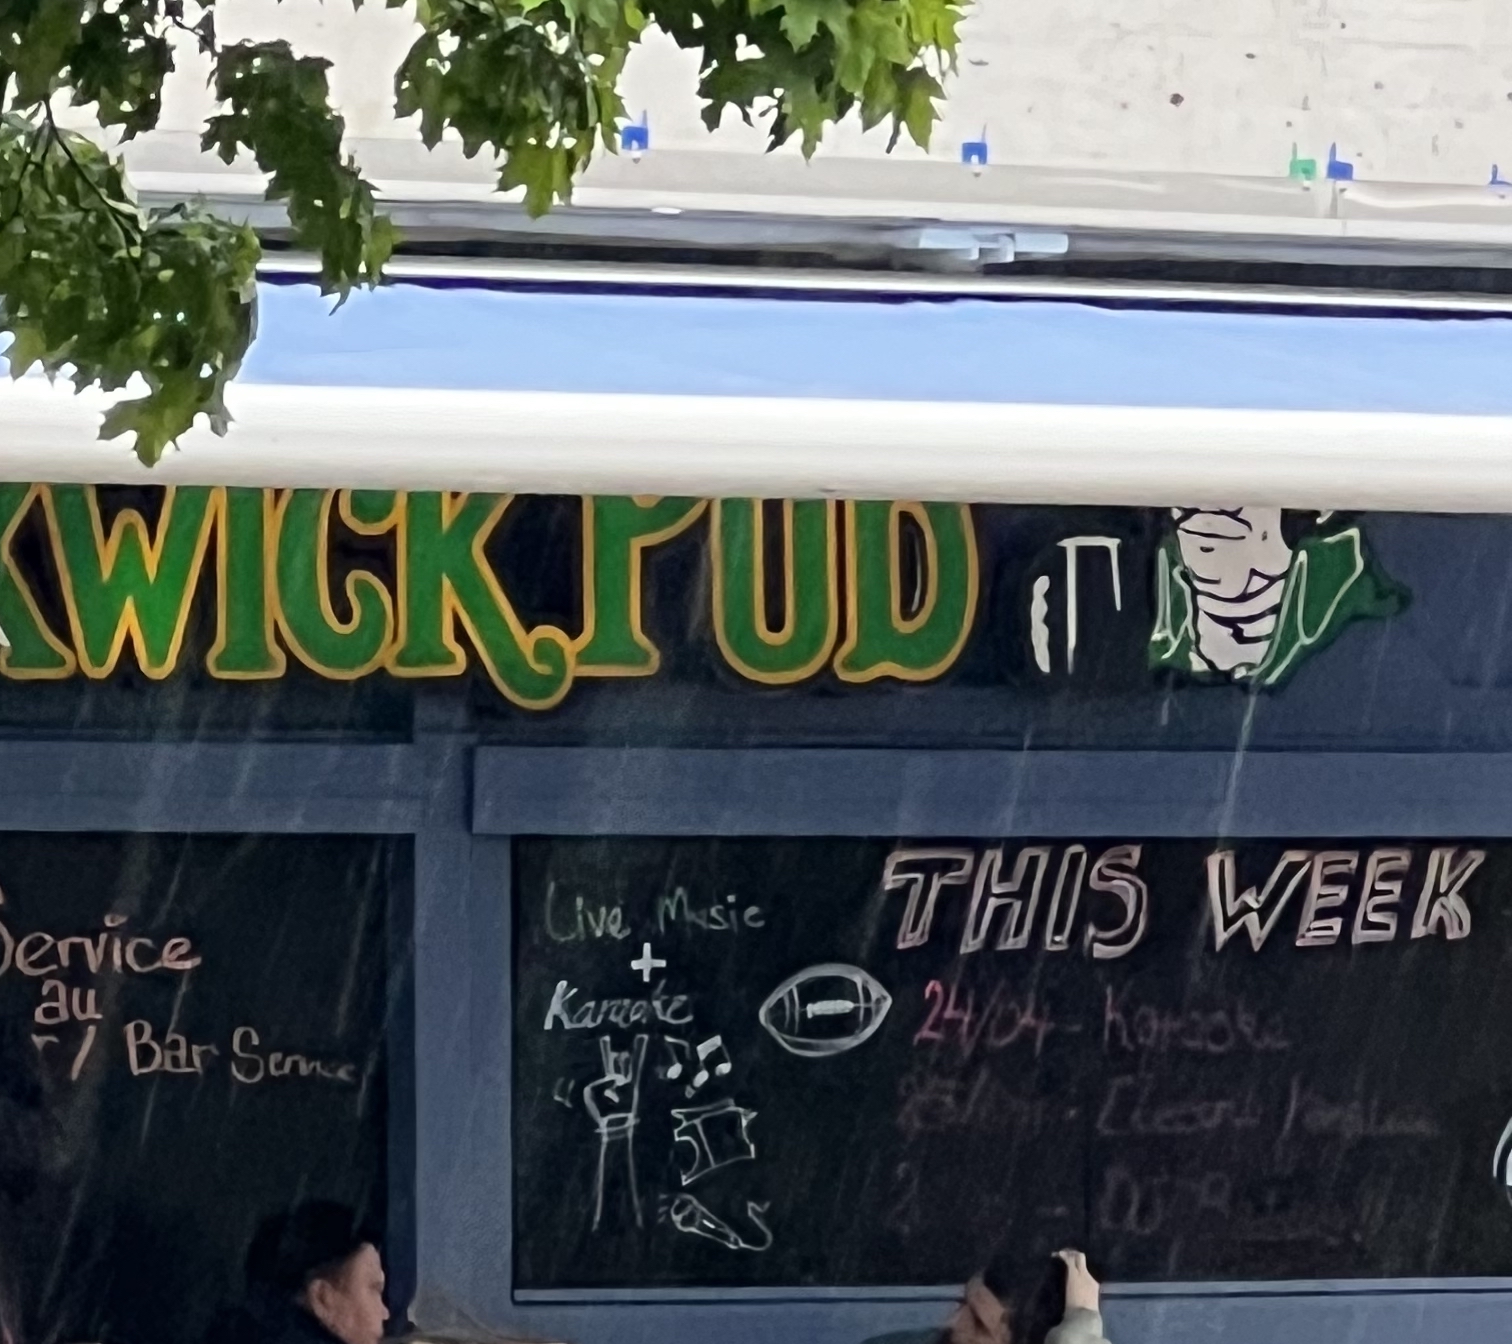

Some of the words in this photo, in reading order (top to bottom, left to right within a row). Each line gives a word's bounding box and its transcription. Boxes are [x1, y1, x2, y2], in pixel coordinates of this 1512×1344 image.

[884, 843, 1149, 958] THIS
[1206, 848, 1486, 953] WEEK
[33, 978, 104, 1025] au
[123, 1018, 220, 1077] Bar
